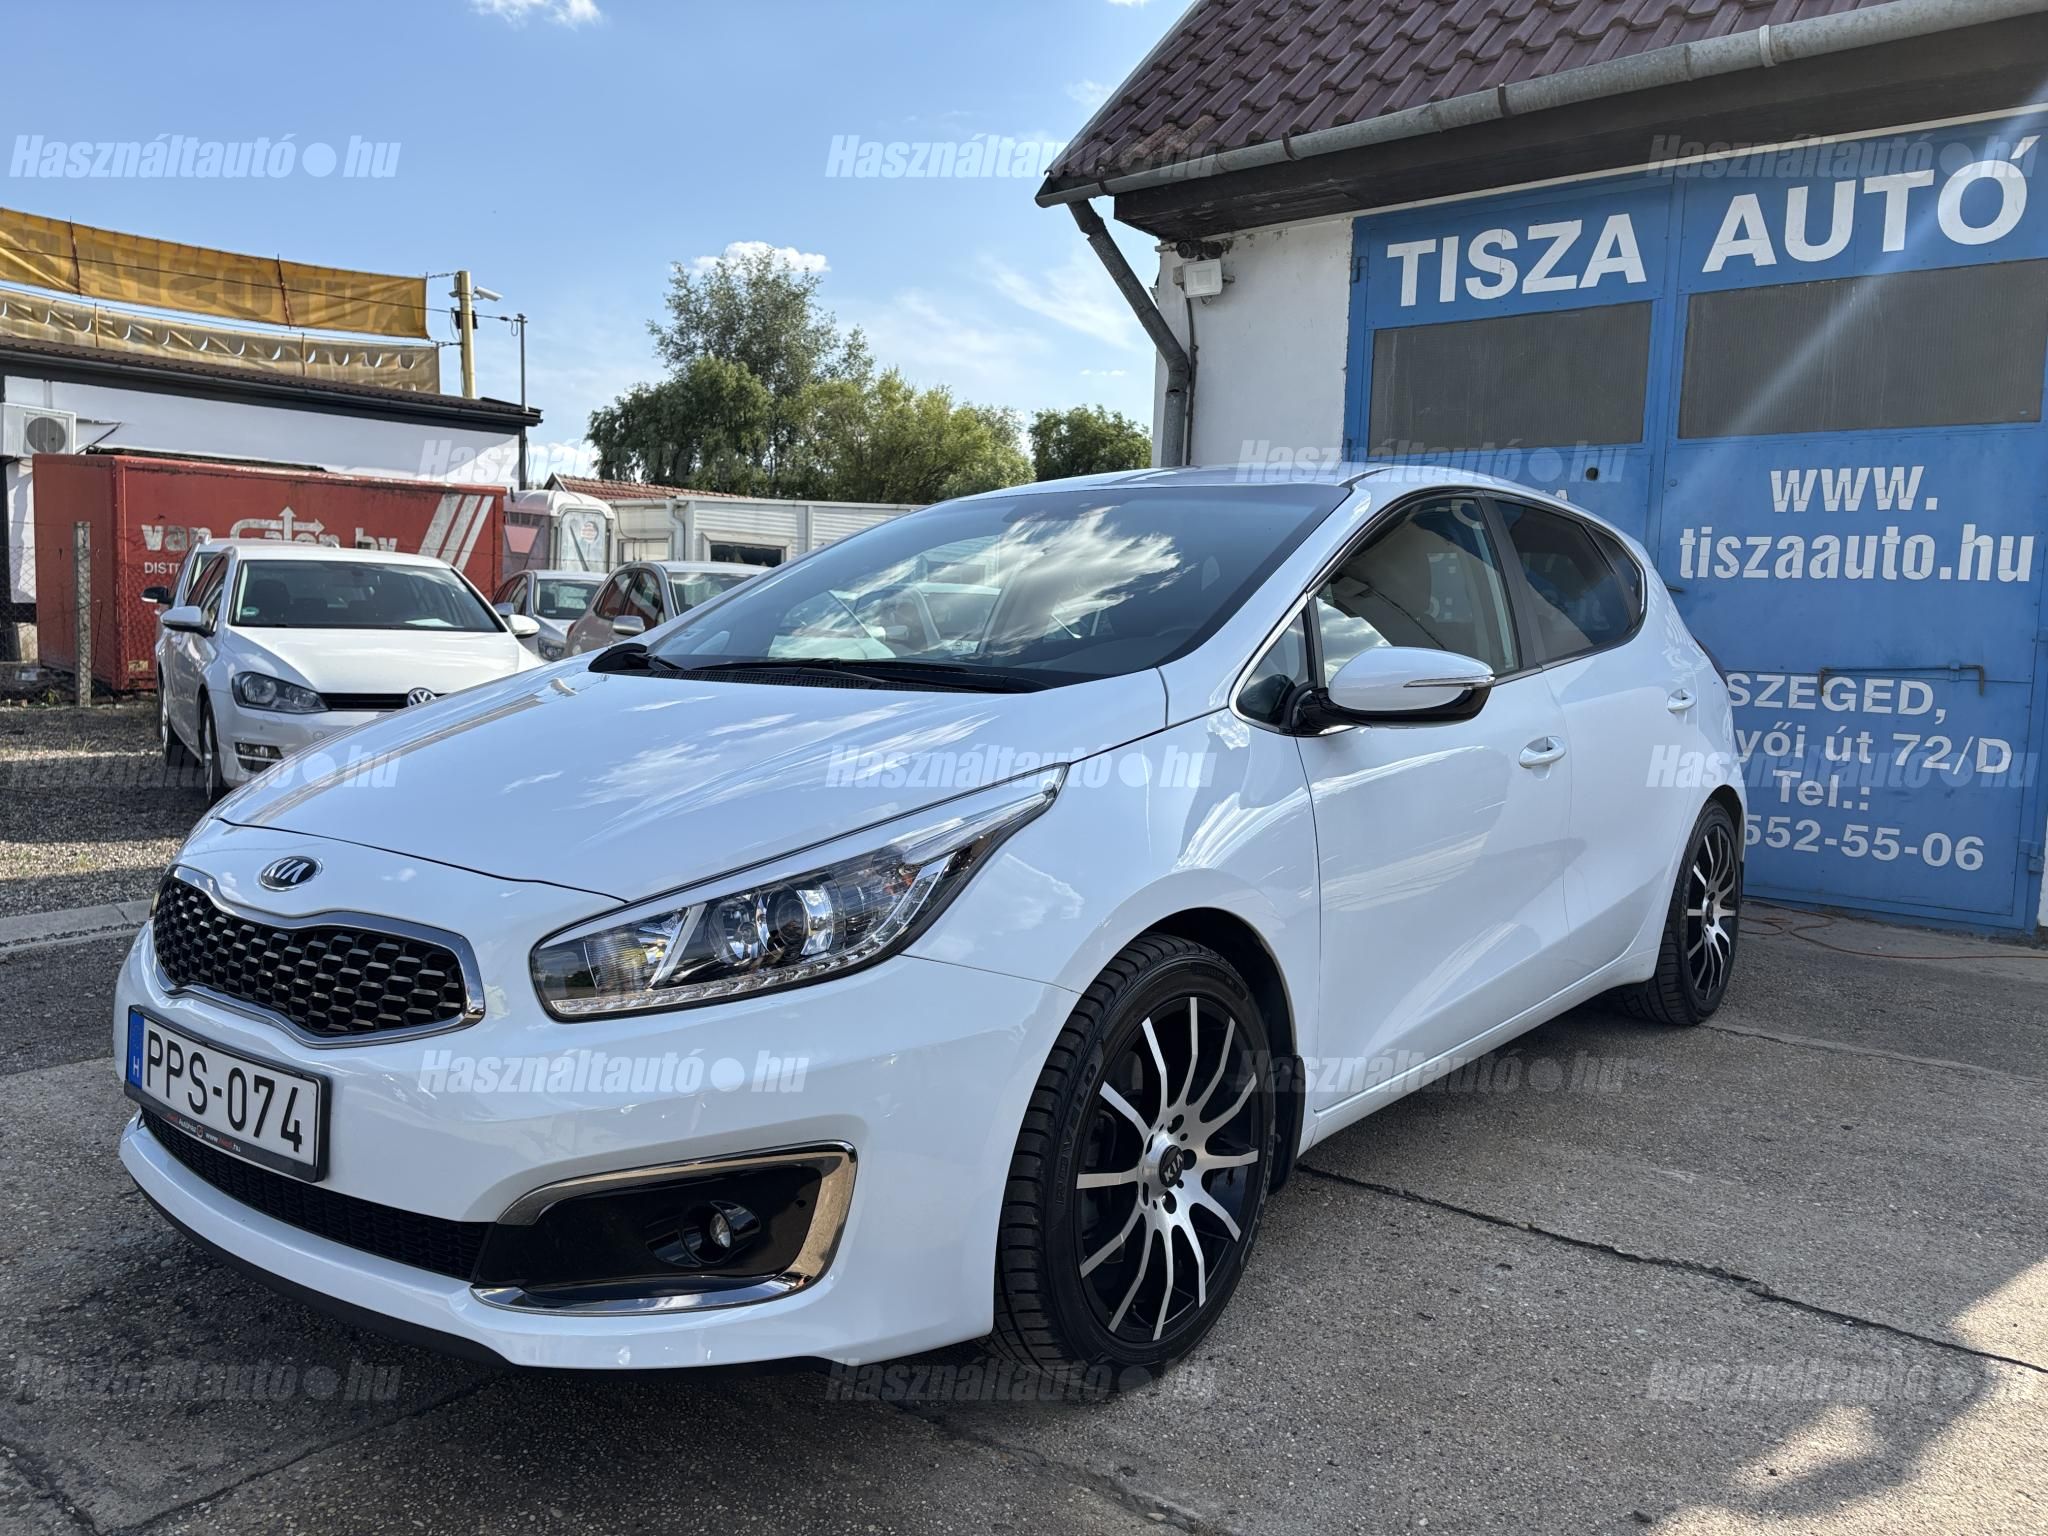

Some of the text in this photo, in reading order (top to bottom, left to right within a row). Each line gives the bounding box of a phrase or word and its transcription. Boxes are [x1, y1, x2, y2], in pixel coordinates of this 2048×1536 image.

[1387, 135, 2040, 307] TISZA AUTÓ
[1770, 465, 1938, 513] www.
[141, 524, 213, 551] van
[1679, 523, 2035, 583] tiszaauto.hu
[1727, 672, 1947, 724] SZEGED,
[1824, 726, 1874, 764] út
[1893, 733, 2013, 776] 72/D
[1772, 769, 1871, 811] Tel.:
[1745, 814, 1985, 873] 552-55-06
[264, 858, 301, 886] KIA
[147, 1028, 303, 1153] PPS-074
[1163, 1153, 1183, 1183] KIA
